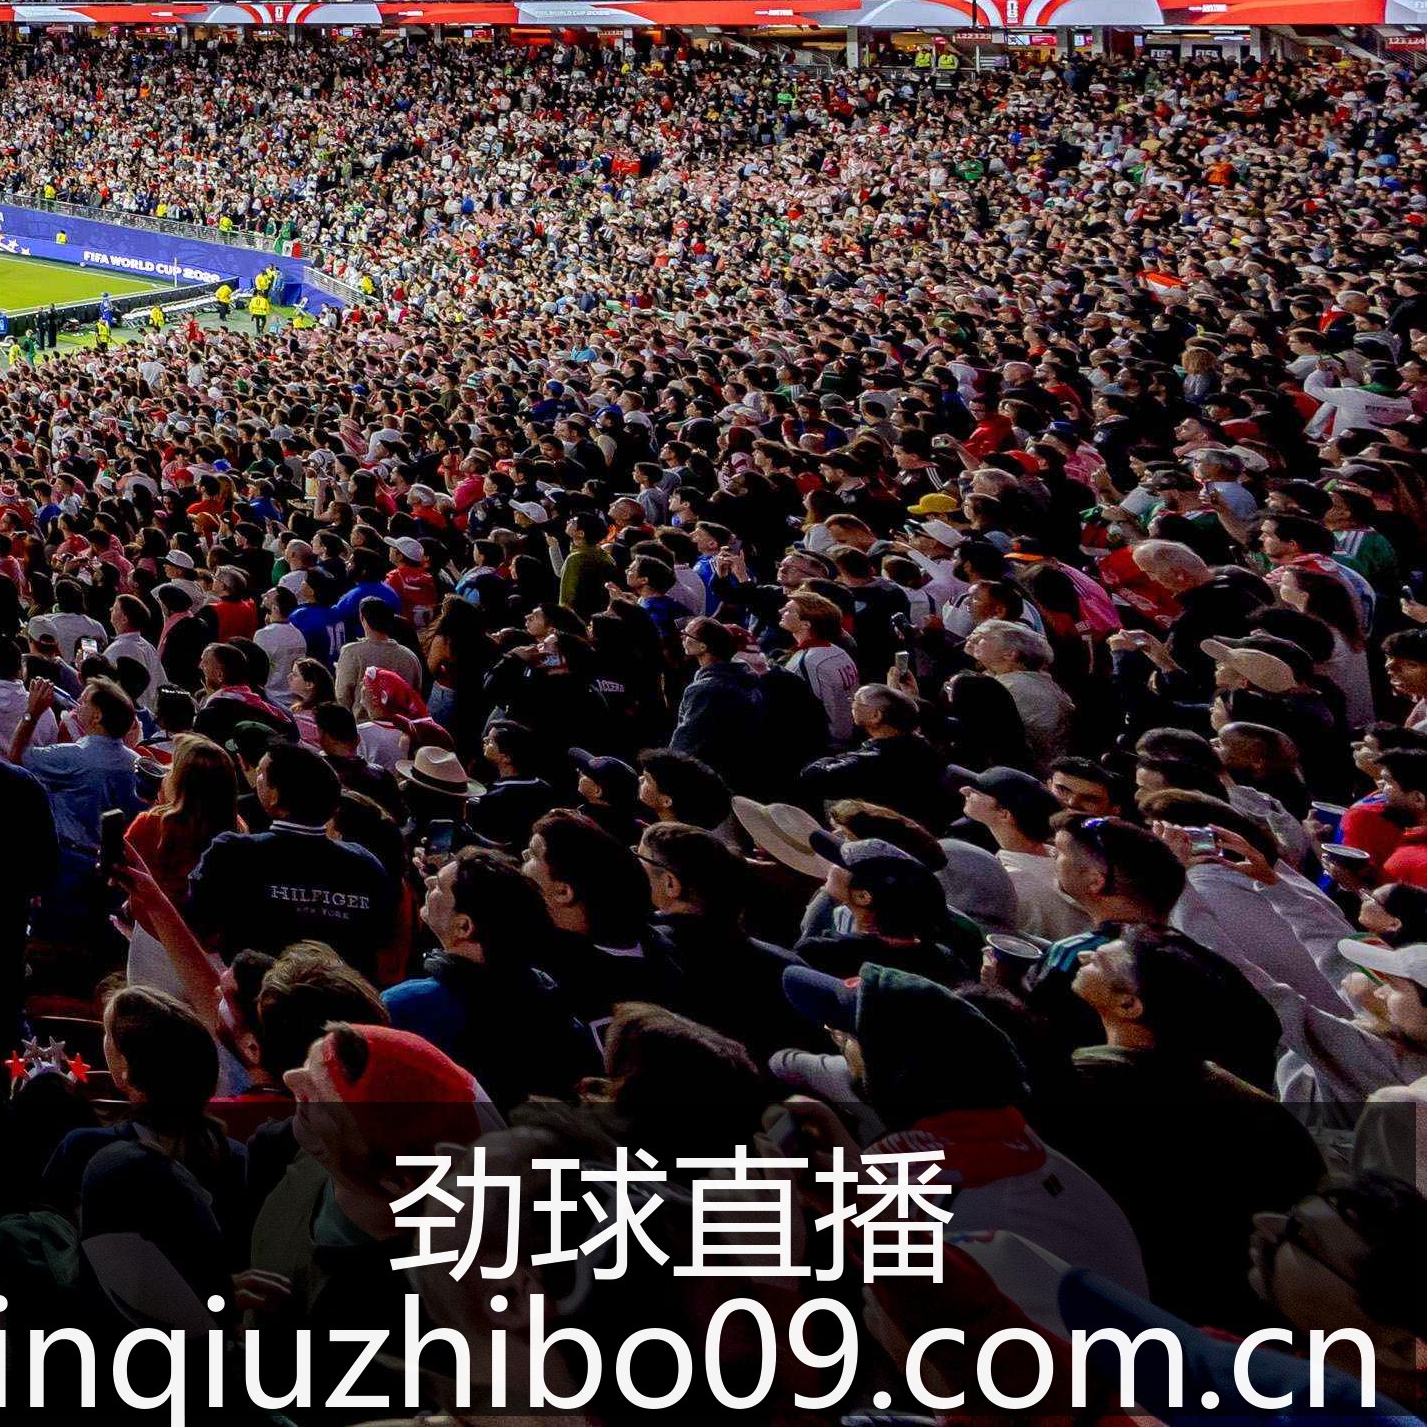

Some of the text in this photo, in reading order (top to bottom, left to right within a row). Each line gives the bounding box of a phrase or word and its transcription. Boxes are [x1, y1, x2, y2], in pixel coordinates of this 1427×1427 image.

[83, 251, 111, 265] FIFA
[110, 255, 154, 272] WORLD
[156, 263, 182, 275] CUP
[270, 885, 370, 910] HILFIGER
